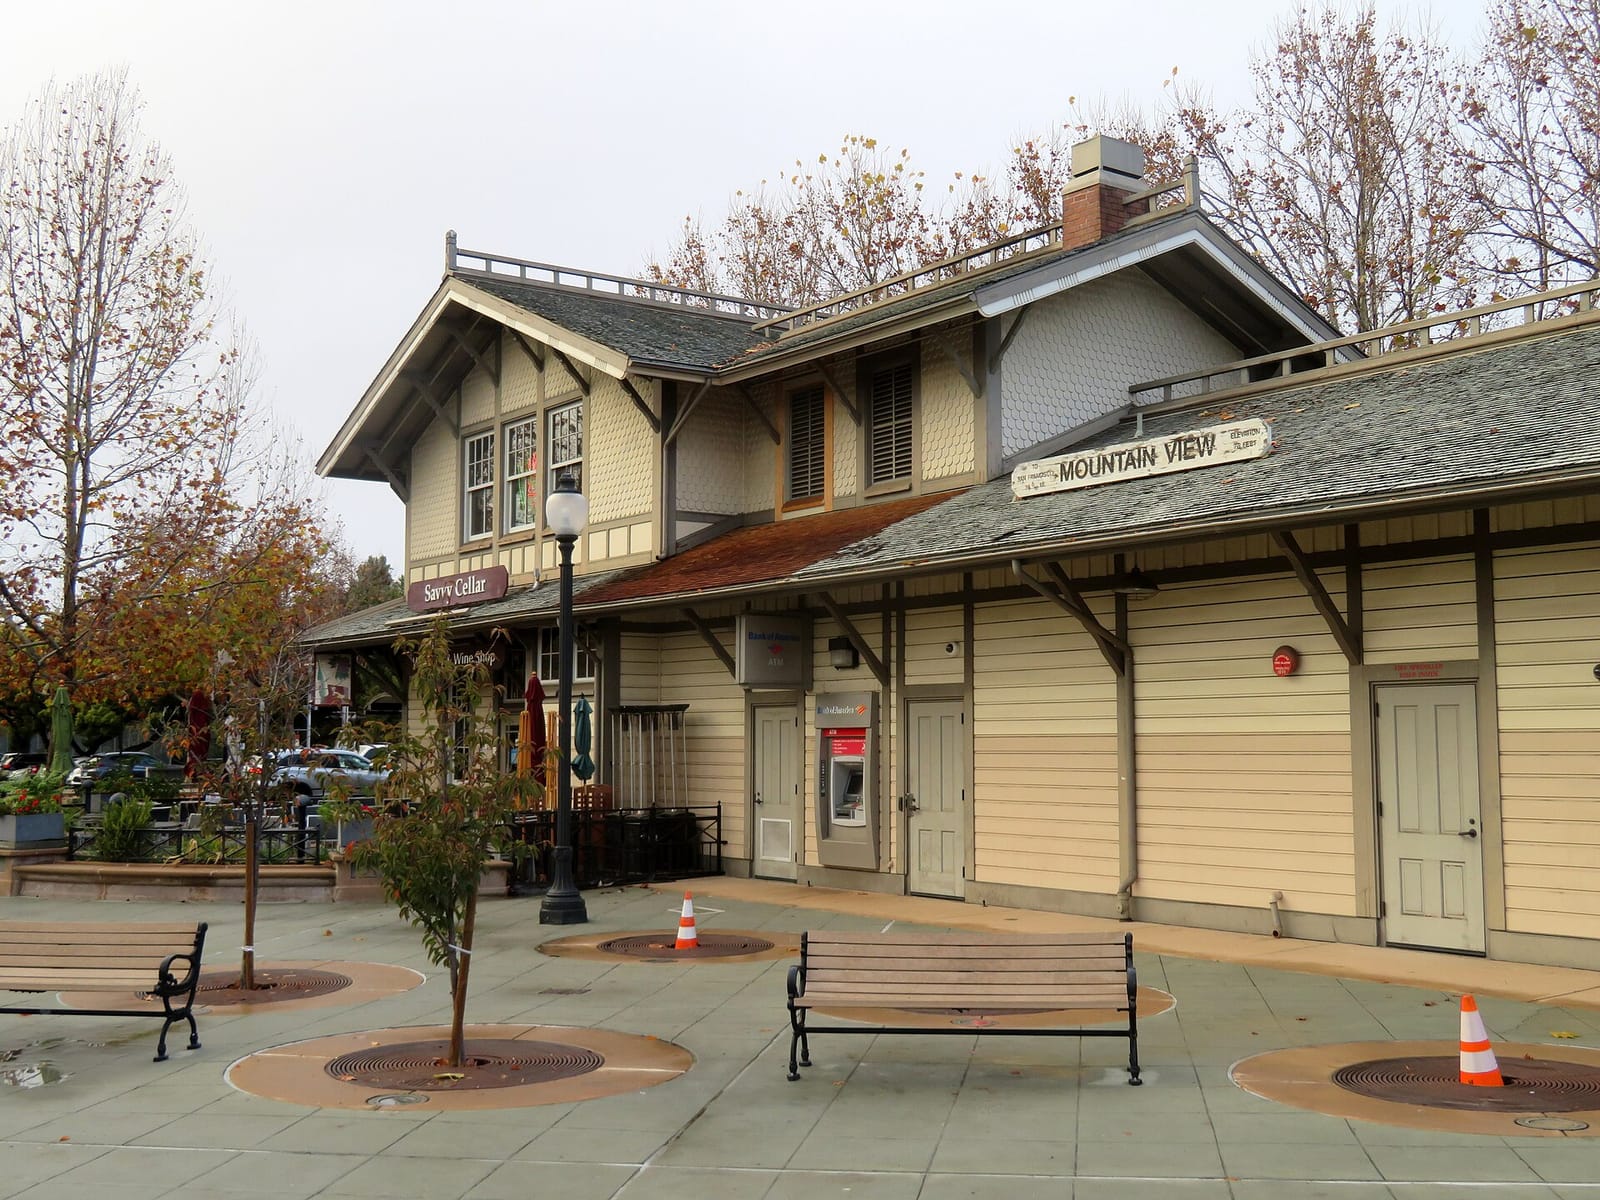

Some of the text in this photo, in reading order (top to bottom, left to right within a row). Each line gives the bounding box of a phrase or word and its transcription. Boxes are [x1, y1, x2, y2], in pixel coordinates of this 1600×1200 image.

[1059, 432, 1216, 482] MOUNTAIN VIEW
[424, 576, 486, 604] Savvy Cellar
[453, 652, 474, 665] Wine
